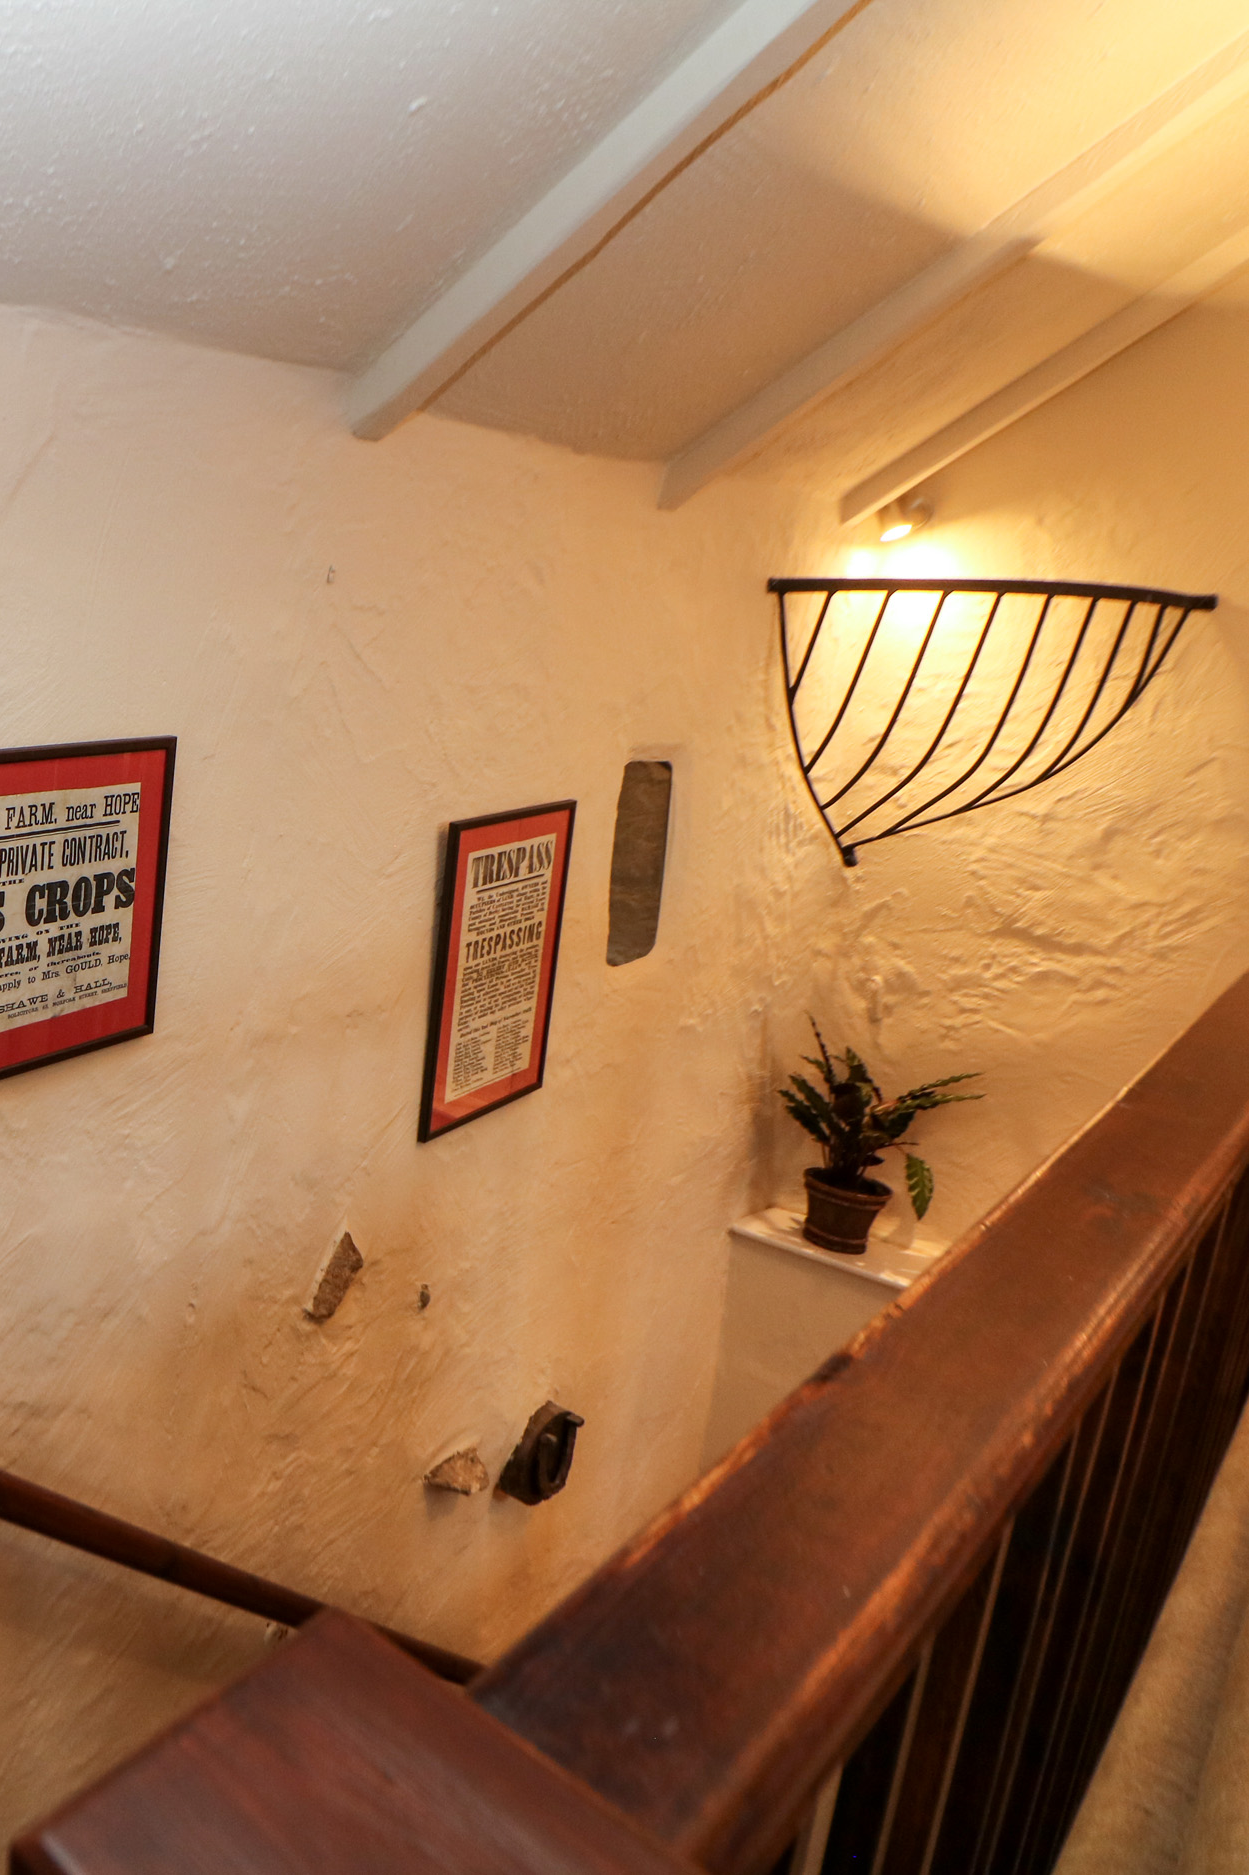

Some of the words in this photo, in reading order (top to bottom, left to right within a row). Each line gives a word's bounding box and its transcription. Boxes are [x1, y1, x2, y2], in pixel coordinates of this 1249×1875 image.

[66, 803, 96, 822] near
[103, 792, 139, 817] HOPE
[62, 830, 128, 867] CONTRACT,
[471, 840, 553, 889] TRESPASS
[0, 878, 25, 886] THE
[25, 868, 135, 927] CROPS
[46, 930, 82, 957] NEAR
[88, 922, 122, 948] HOPE,
[58, 923, 81, 931] THE
[465, 921, 542, 963] TRESPASSING
[28, 976, 36, 984] to
[57, 989, 65, 998] &
[74, 978, 112, 994] HALL,
